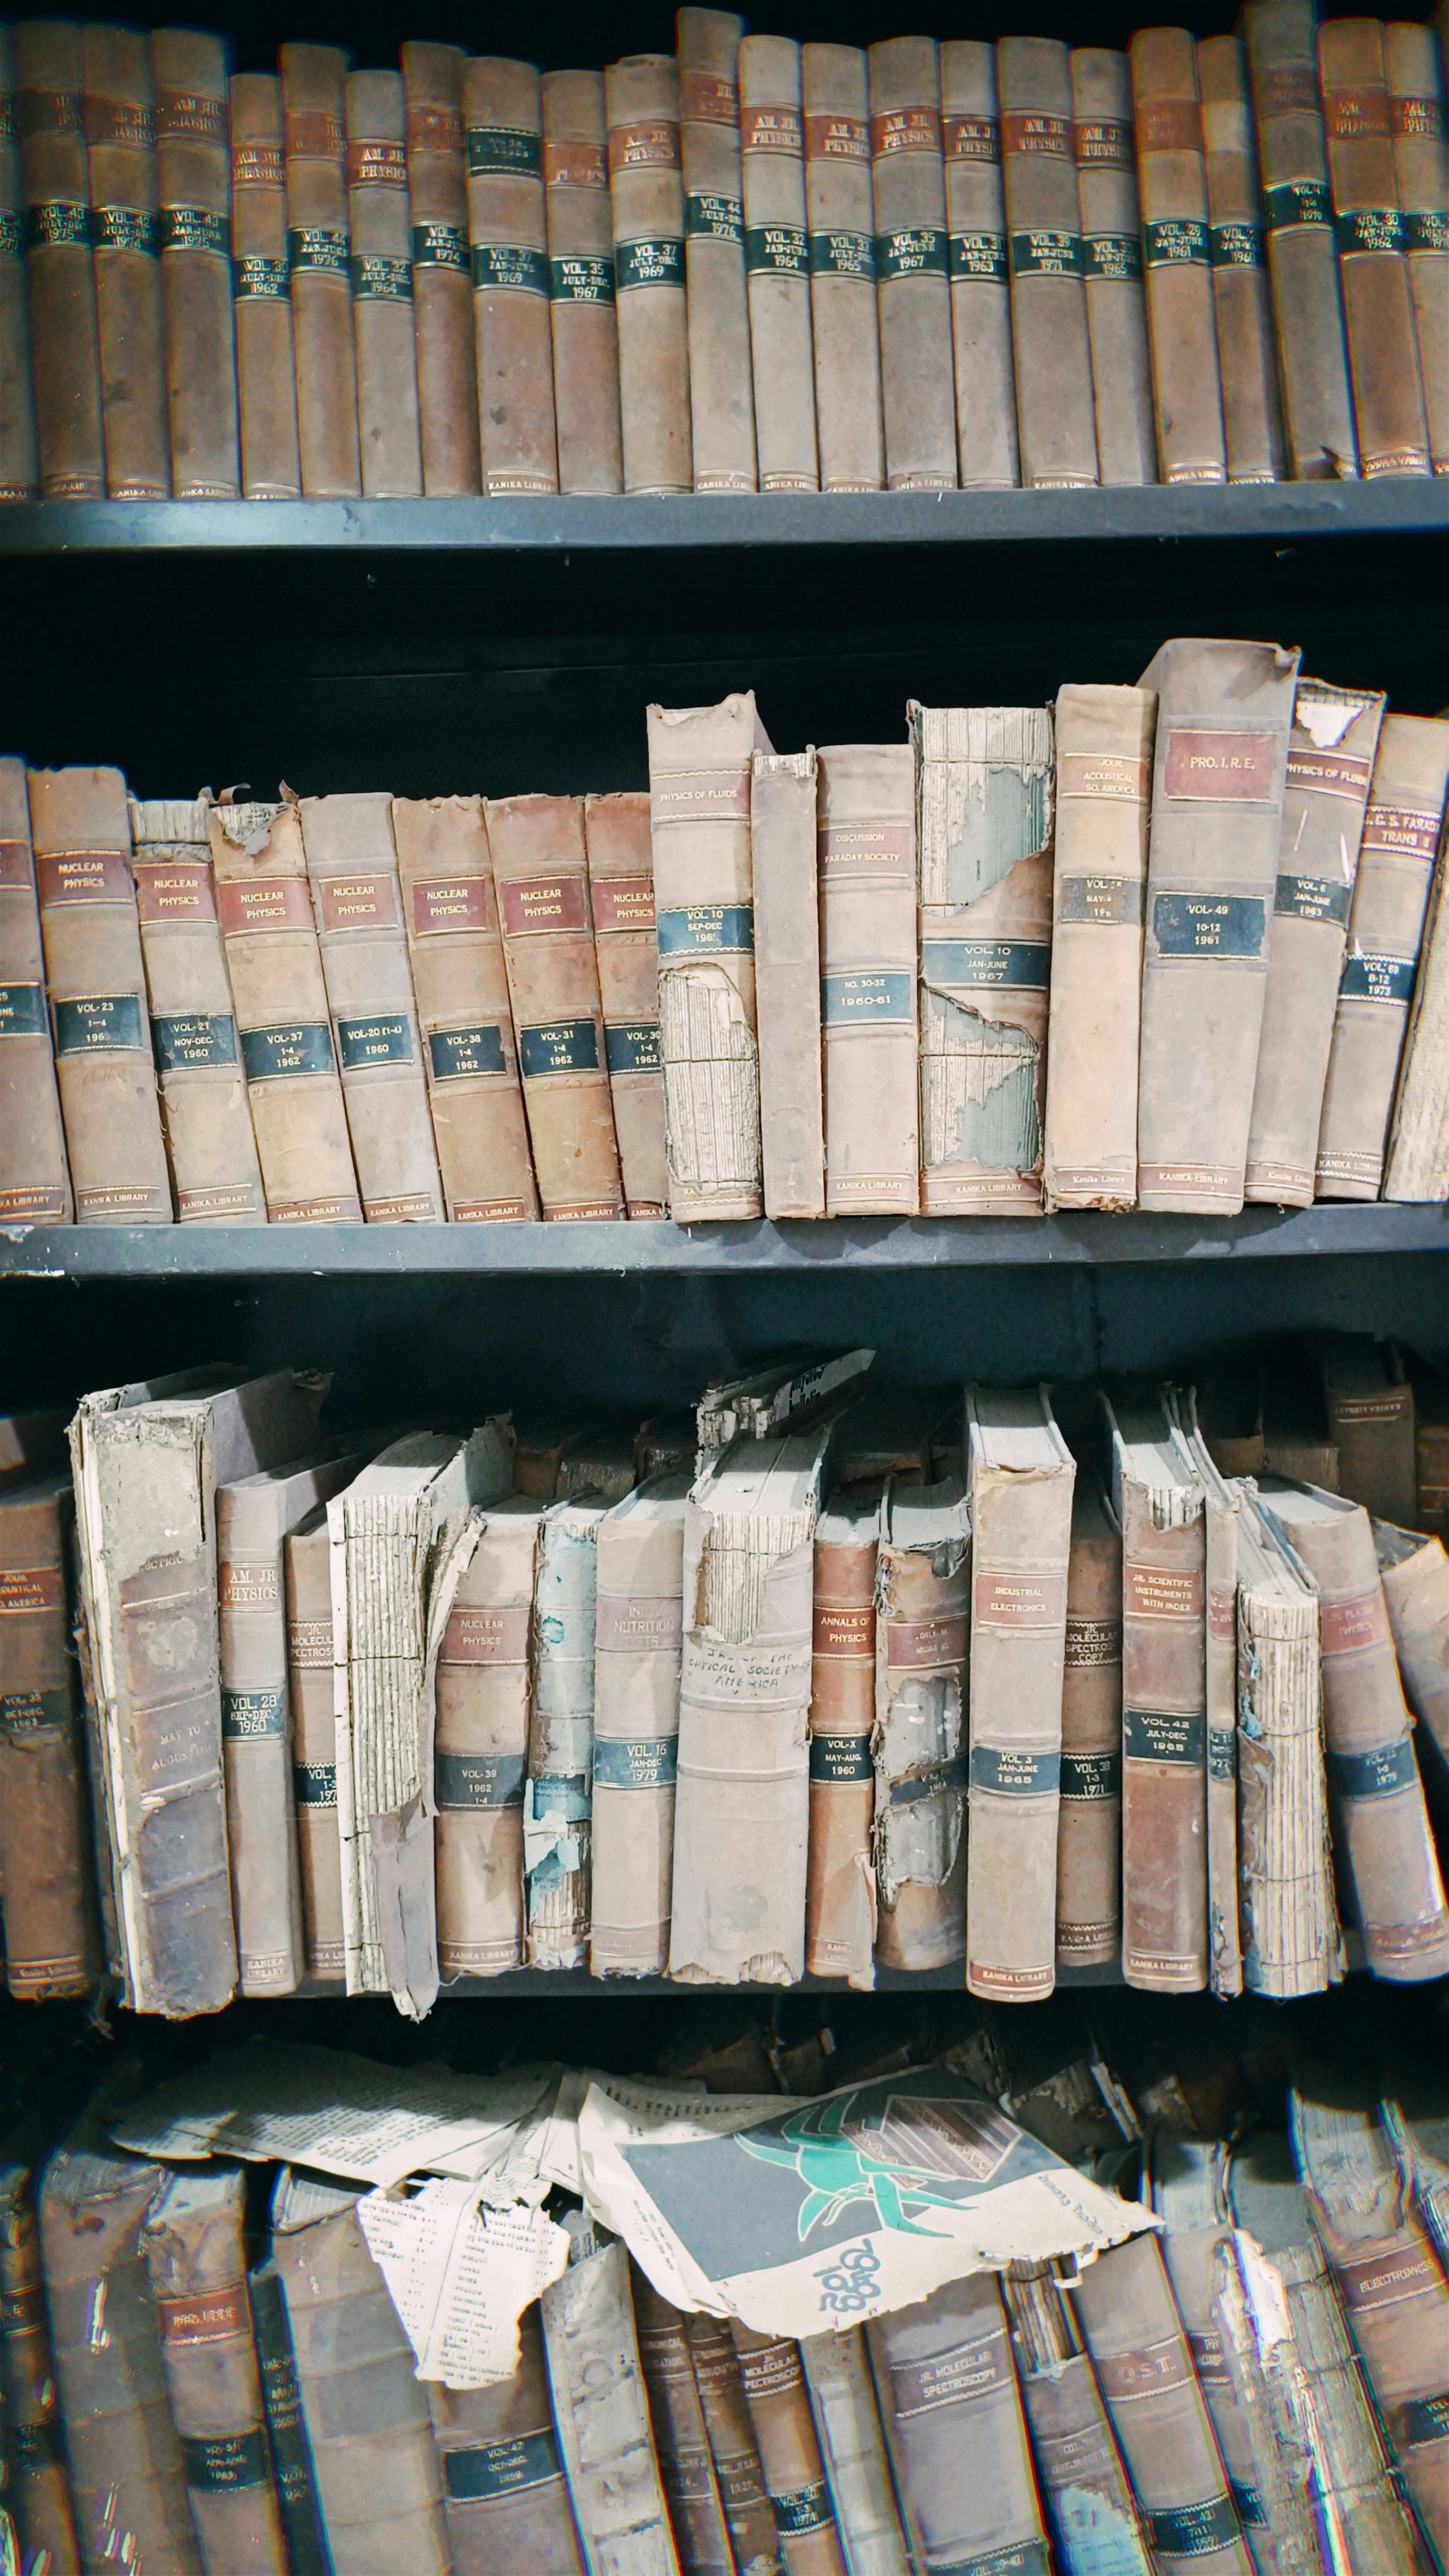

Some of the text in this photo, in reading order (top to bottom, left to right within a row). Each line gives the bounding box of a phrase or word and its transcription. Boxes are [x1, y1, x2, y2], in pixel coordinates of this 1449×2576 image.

[755, 116, 778, 128] AM.
[751, 132, 801, 146] PHYSICS
[882, 130, 934, 148] PHYSICS
[727, 202, 740, 213] 44
[711, 222, 737, 236] 1976
[1186, 225, 1201, 236] 29
[792, 233, 805, 245] 32
[921, 232, 936, 243] 35
[662, 245, 676, 255] 37
[1167, 247, 1192, 258] 1961
[312, 254, 338, 266] 1976
[774, 255, 798, 268] 1964
[837, 259, 861, 271] 1965
[899, 256, 925, 269] 1967
[589, 263, 604, 274] 35
[639, 266, 664, 278] 1969
[969, 261, 994, 272] 1963
[497, 271, 522, 283] 1969
[562, 275, 610, 287] JULY-DEC.
[251, 284, 278, 294] 1962
[371, 283, 398, 293] 1964
[573, 287, 597, 298] 1967
[1084, 772, 1133, 783] ACOUSTICAL
[661, 791, 693, 803] PHYSICS
[709, 790, 738, 798] FLUIDS
[836, 834, 884, 843] DISCUSSION
[1382, 831, 1417, 845] TRANS
[825, 853, 899, 863] FARADAY SOCIETY
[58, 863, 104, 875] NUCLEAR
[64, 878, 105, 890] PHYSICS
[155, 880, 198, 889] NUCLEAR
[333, 886, 374, 896] NUCLEAR
[427, 890, 468, 900] NUCLEAR
[521, 890, 561, 901] NUCLEAR
[159, 897, 199, 906] PHYSICS
[241, 892, 284, 903] NUCLEAR
[613, 893, 653, 902] NUCLEAR
[1294, 893, 1331, 905] JAN-JUNE
[246, 908, 286, 918] PHYSICS
[339, 905, 376, 915] PHYSICS
[431, 905, 468, 915] PHYSICS
[525, 905, 561, 916] PHYSICS
[617, 908, 653, 918] PHYSICS
[1299, 906, 1321, 916] 1963
[1196, 923, 1220, 932] 10-12
[1195, 935, 1220, 945] 1961
[967, 961, 1008, 969] JAN-JUNE
[845, 979, 885, 989] NO. 30-32
[1368, 985, 1392, 996] 1973
[841, 996, 891, 1006] 1960-61
[184, 1049, 209, 1058] 1960
[366, 1045, 389, 1054] 1960
[277, 1057, 300, 1067] 1962
[456, 1060, 479, 1070] 1962
[550, 1055, 573, 1065] 1962
[635, 1055, 658, 1064] 1962
[1319, 1160, 1351, 1169] KANIKA
[1073, 1176, 1125, 1184] Kanika Library
[1159, 1173, 1228, 1184] KANIKA LIBRARY
[836, 1181, 903, 1190] KANIKA LIBRARY
[956, 1183, 1022, 1194] KANIKA LIBRARY
[85, 1194, 148, 1206] KANIKA LIBRARY
[182, 1195, 248, 1211] KANIKA LIBRARY
[458, 1207, 518, 1221] KANIKA LIBRARY
[553, 1209, 613, 1221] KANIKA LIBRARY
[1148, 1577, 1193, 1588] SCIENTIFIC
[224, 1587, 278, 1601] PHYSICS
[995, 1587, 1043, 1596] INDUSTRIAL
[1135, 1587, 1192, 1599] INSTRUMENTS
[991, 1603, 1046, 1612] ELECTRONICS
[1143, 1598, 1191, 1611] WITH INDEX
[461, 1620, 503, 1629] NUCLEAR
[614, 1621, 675, 1633] NUTRITION
[821, 1617, 857, 1626] ANNALS
[830, 1633, 867, 1642] PHYSICS
[231, 1695, 277, 1708] VOL. 28
[231, 1710, 274, 1720] SEP-DEC.
[240, 1721, 266, 1733] 1960
[828, 1740, 855, 1749] VOL-X
[1153, 1742, 1184, 1751] 1965
[627, 1744, 667, 1757] VOL. 16
[1001, 1754, 1022, 1763] VOL.
[831, 1766, 855, 1775] 1960
[998, 1764, 1038, 1773] JAN-JUNE
[309, 1769, 333, 1780] VOL.
[632, 1769, 657, 1781] 1979
[998, 1775, 1032, 1784] 1965
[1083, 1785, 1104, 1797] 1971
[482, 1950, 516, 1959] LIBRARY
[247, 1957, 284, 1969] KANIKA
[247, 1967, 285, 1977] LIBRARY
[982, 1971, 1047, 1983] KANIKA LIBRARY
[1360, 2259, 1434, 2292] ELECTRONICS
[203, 2306, 235, 2320] IEEE
[918, 2351, 991, 2383] JR. MOLECULAR
[923, 2368, 997, 2398] SPECTROSCOPY
